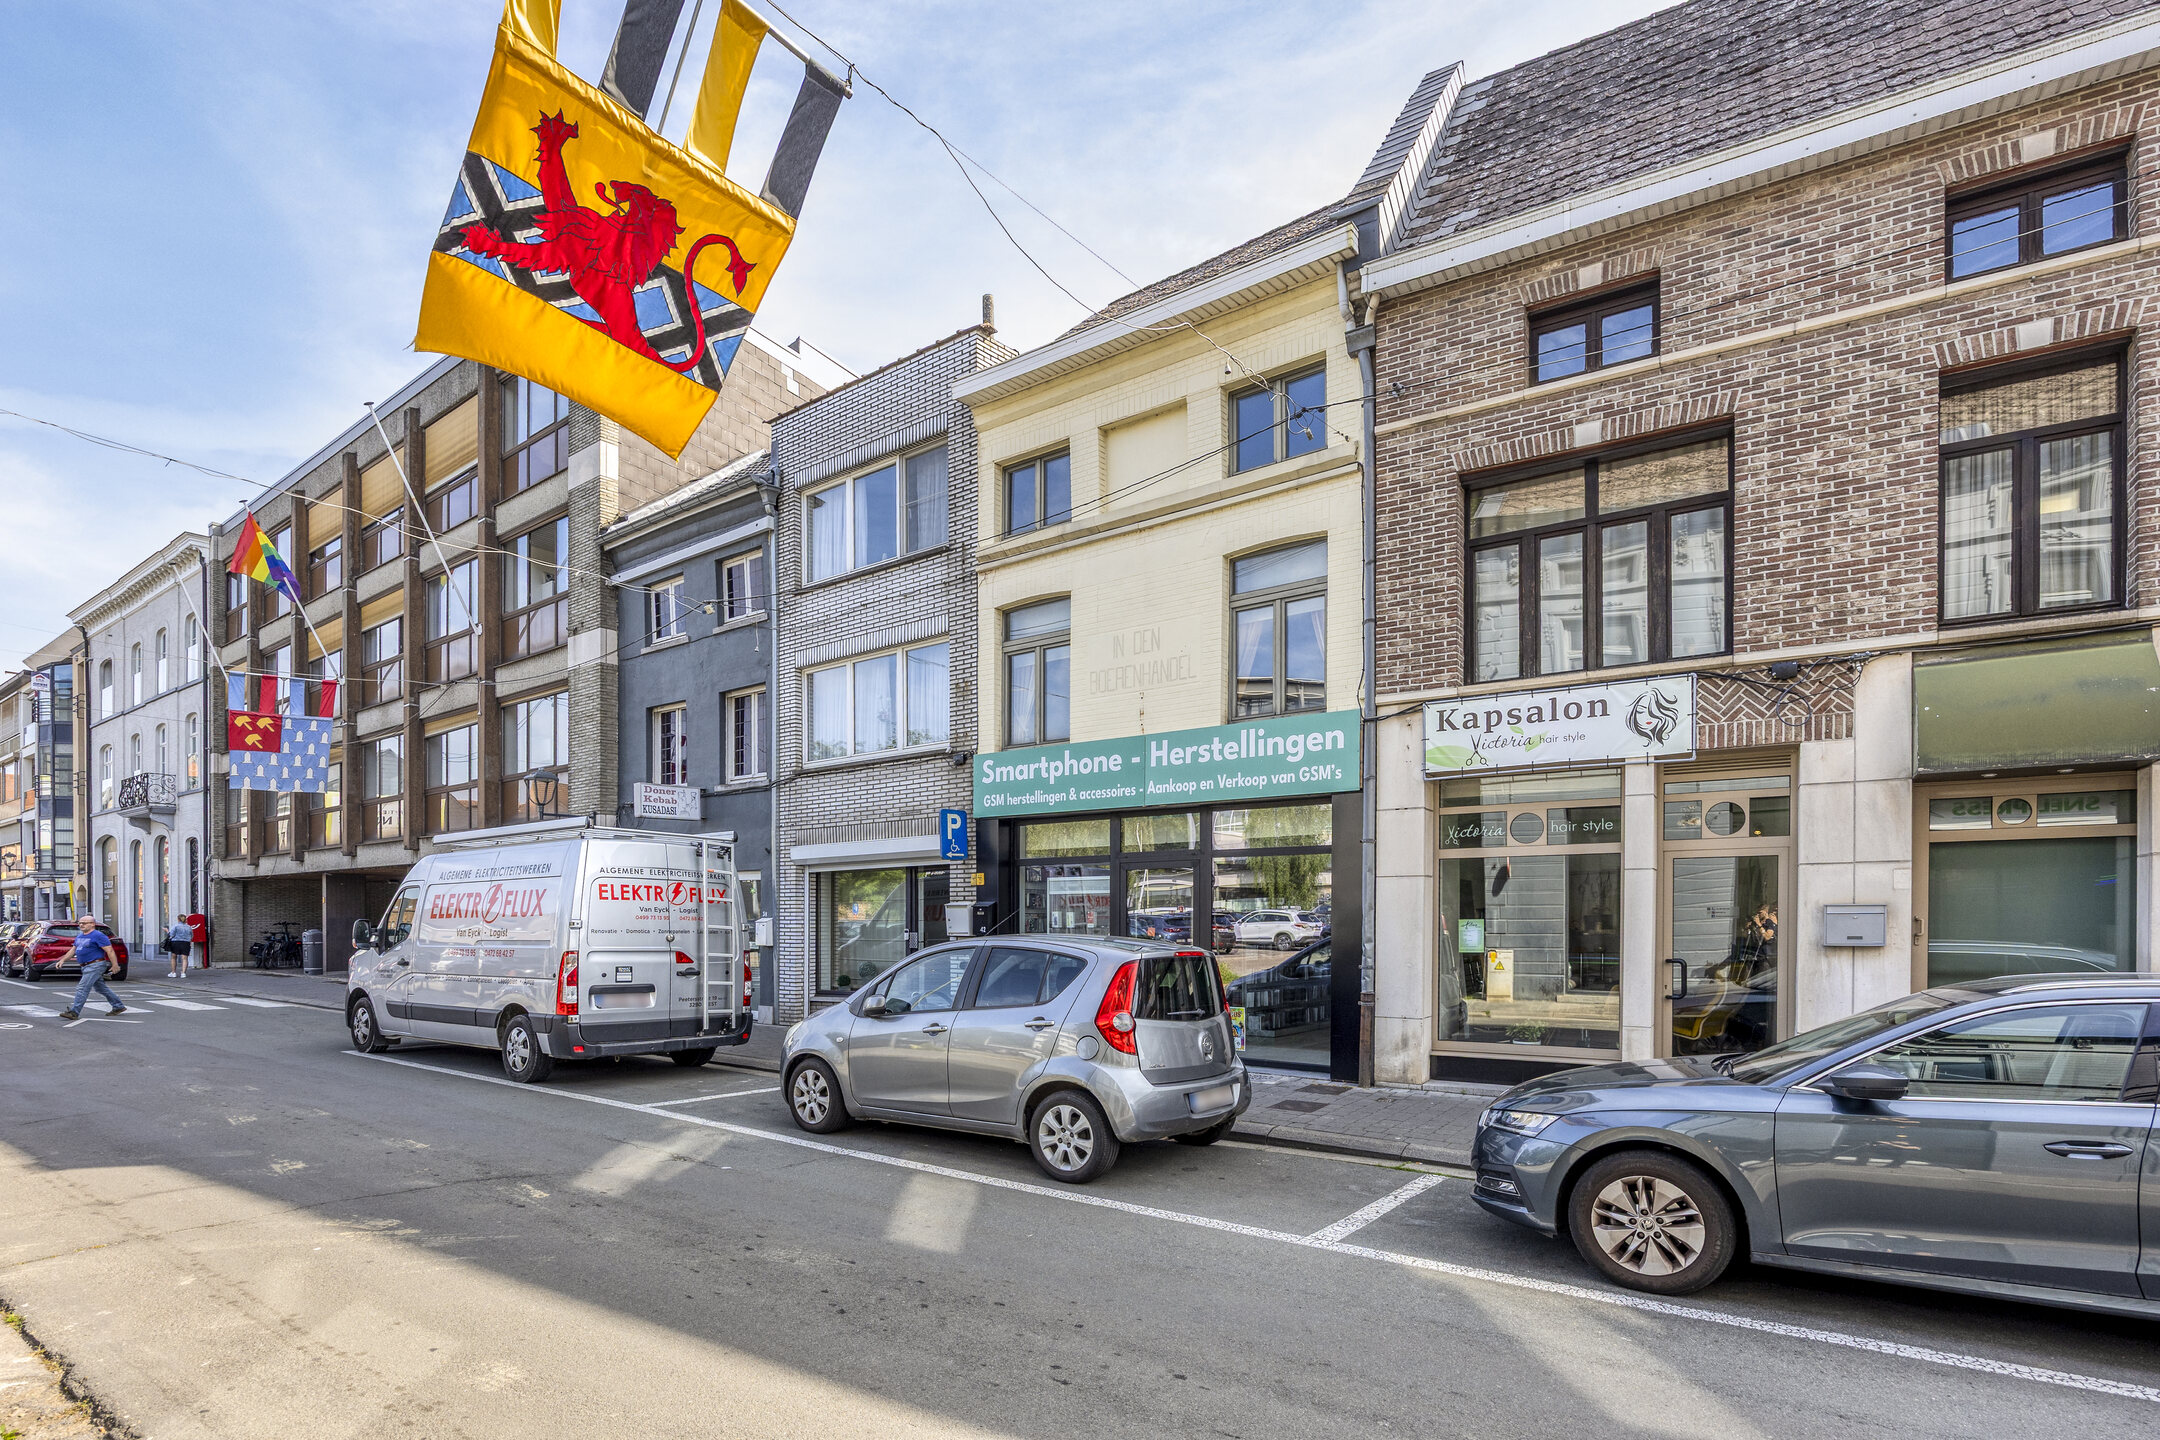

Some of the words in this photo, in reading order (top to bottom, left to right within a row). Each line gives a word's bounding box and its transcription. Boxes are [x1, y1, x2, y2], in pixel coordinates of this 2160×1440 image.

[1112, 633, 1125, 659] IN
[1133, 627, 1160, 655] DEN
[1089, 653, 1198, 695] BOERENHANDEL
[1436, 697, 1611, 733] Kapsalon
[982, 750, 1122, 785] Smartphone
[1150, 728, 1345, 767] Herstellingen
[1468, 734, 1534, 757] Victoria
[1539, 734, 1559, 744] hair
[1563, 731, 1586, 743] style
[983, 793, 1005, 807] GSM
[1007, 790, 1066, 806] herstellingen
[1069, 787, 1077, 801] &
[1079, 784, 1136, 800] accessoires
[1147, 778, 1197, 795] Aankoop
[1200, 779, 1214, 791] en
[1217, 772, 1267, 789] Verkoop
[1271, 771, 1295, 784] van
[1299, 764, 1342, 782] GSM's
[642, 804, 677, 815] KUSADASI
[643, 795, 678, 805] Kebab
[947, 813, 962, 840] P
[1446, 823, 1505, 842] Victoria
[1551, 821, 1577, 833] hair
[1582, 818, 1614, 834] style
[439, 869, 473, 881] ALGEMENE
[474, 863, 552, 878] ELEKTRICITEITSWERKEN
[599, 867, 644, 875] ALGEMENE
[654, 906, 670, 914] Eyck
[456, 928, 467, 937] Van
[467, 928, 481, 938] Eyck
[489, 928, 509, 939] Logist
